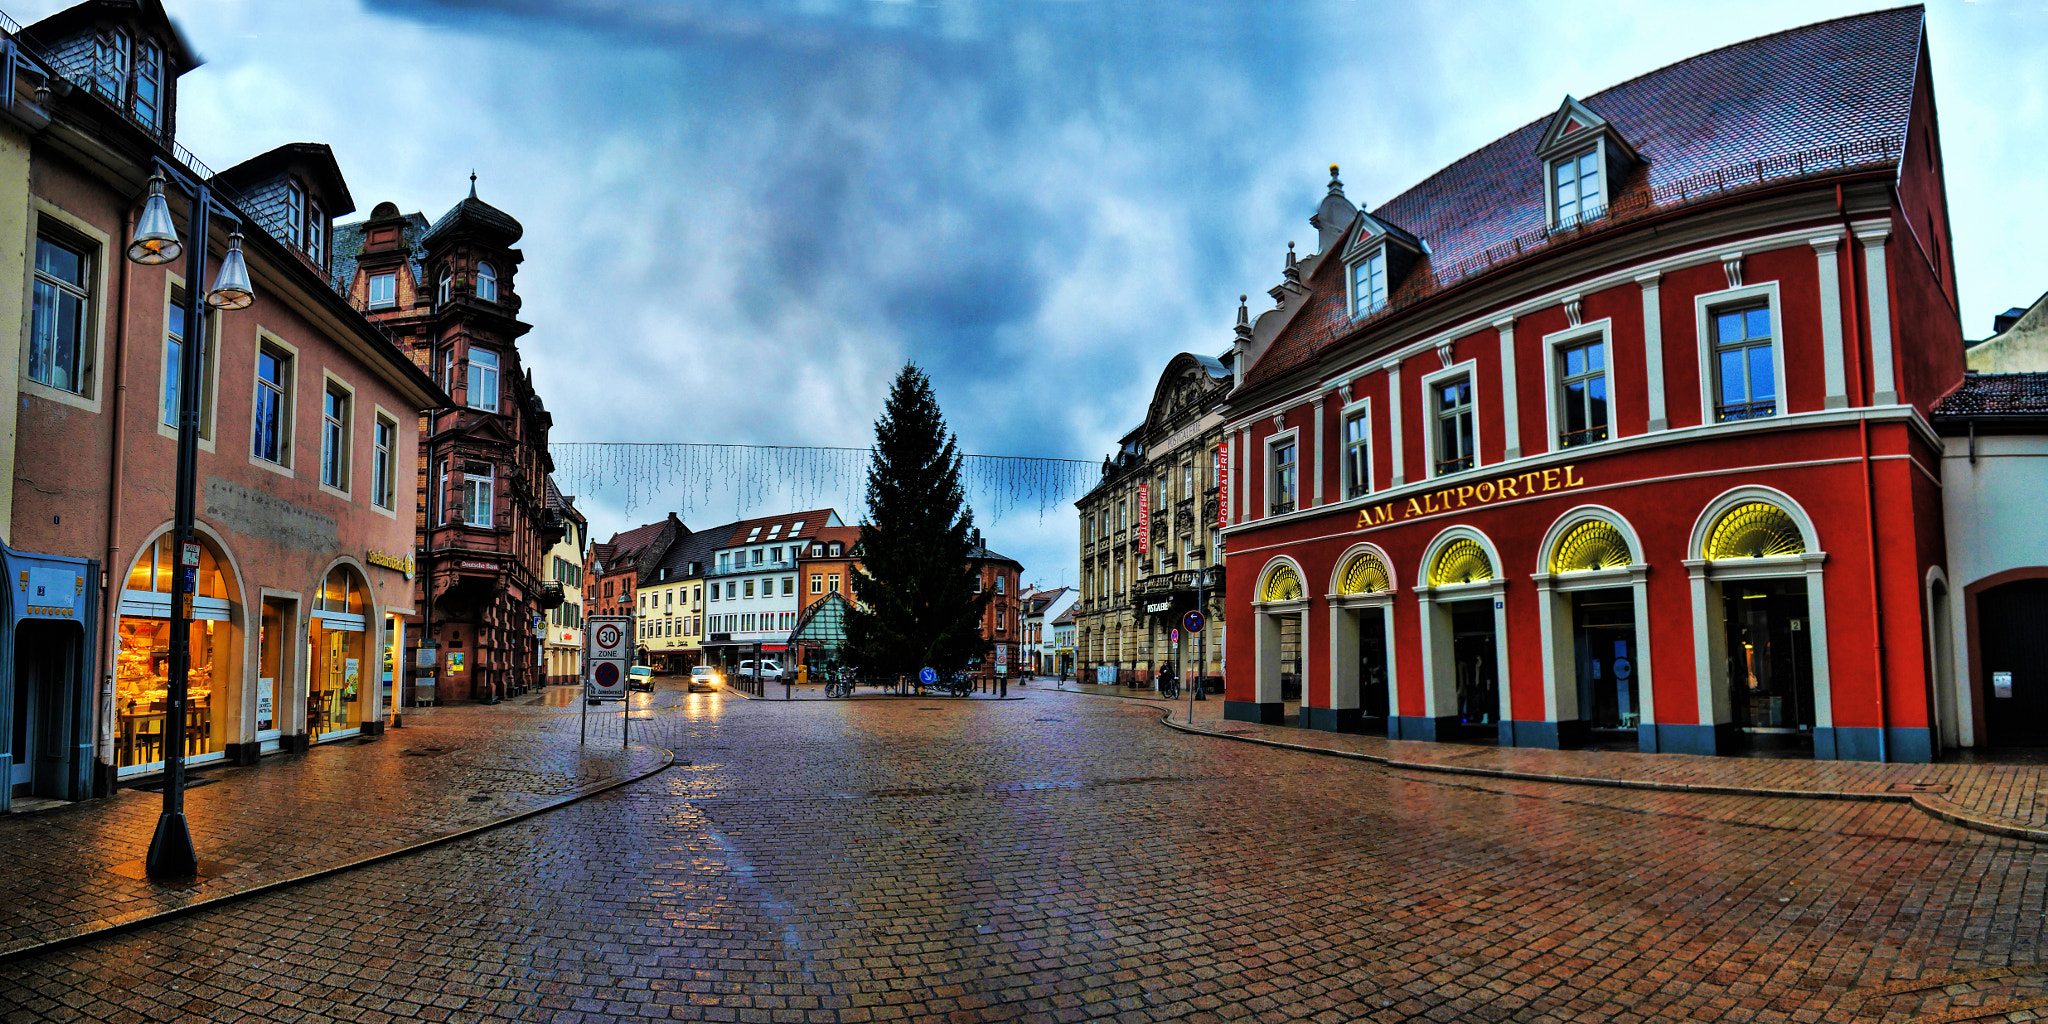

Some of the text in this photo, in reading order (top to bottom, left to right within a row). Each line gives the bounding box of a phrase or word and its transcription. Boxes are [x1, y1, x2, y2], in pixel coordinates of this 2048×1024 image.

[1356, 502, 1394, 528] AM
[462, 560, 499, 570] Deutsche Bank
[601, 631, 615, 643] 30
